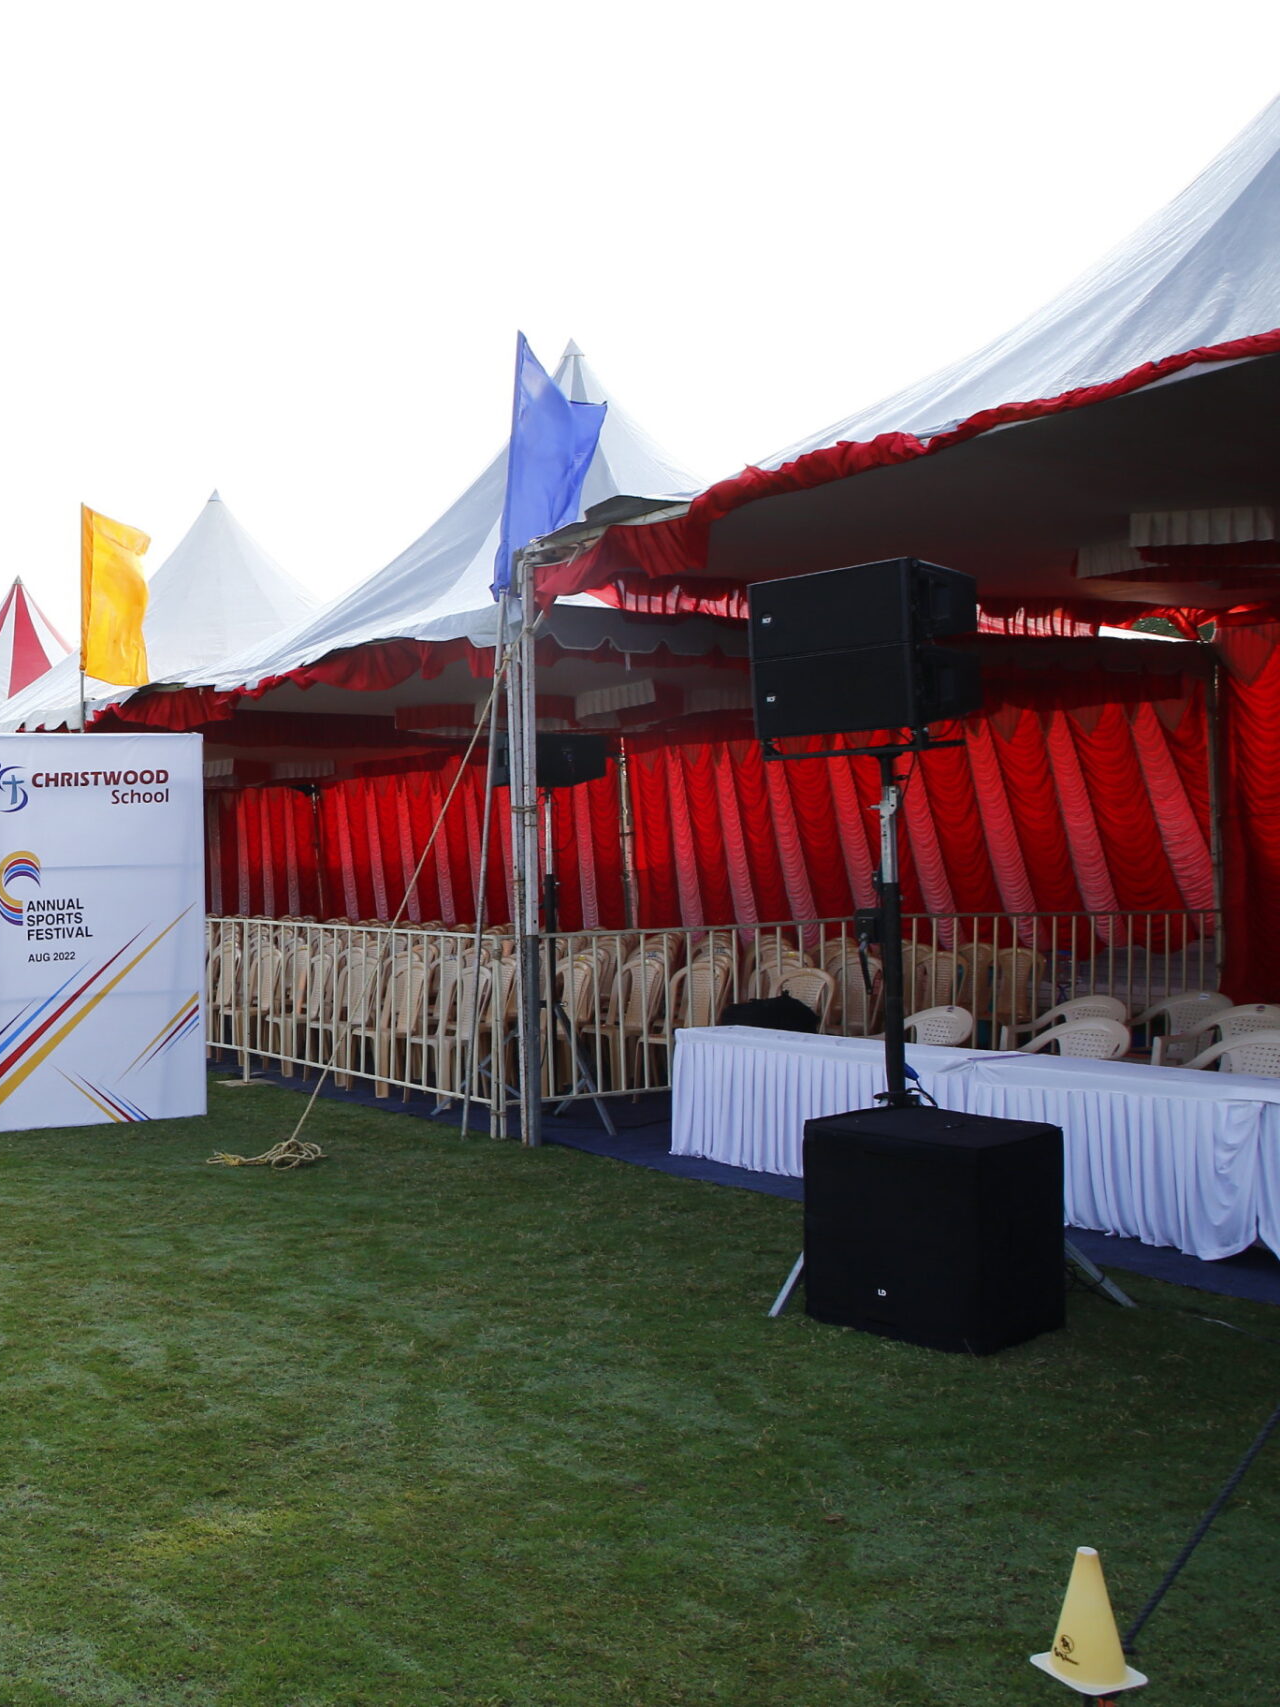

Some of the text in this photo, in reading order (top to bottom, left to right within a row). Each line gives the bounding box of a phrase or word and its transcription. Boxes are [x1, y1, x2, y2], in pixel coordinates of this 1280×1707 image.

[31, 769, 169, 788] CHRISTWOOD
[111, 788, 169, 805] School
[26, 898, 85, 913] ANNUAL
[26, 912, 83, 927] SPORTS
[27, 926, 94, 941] FESTIVAL
[28, 951, 76, 963] AUG 2022
